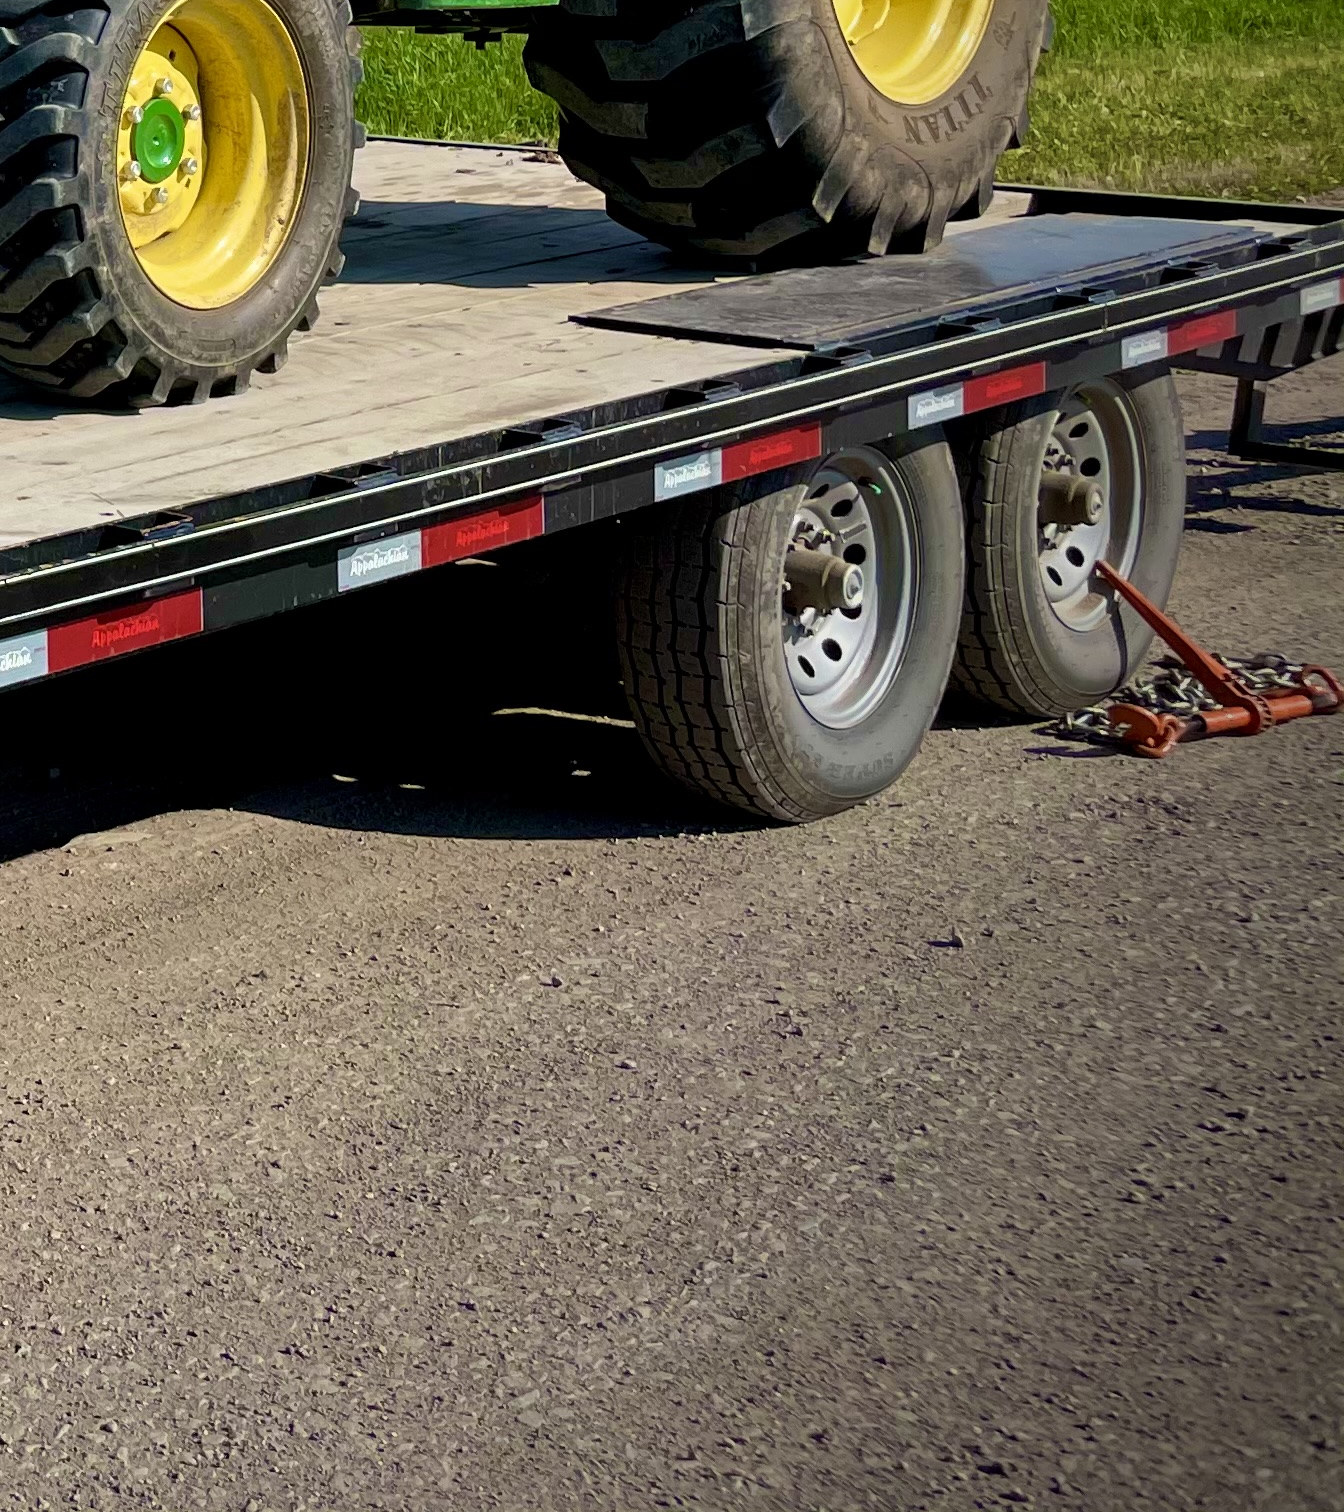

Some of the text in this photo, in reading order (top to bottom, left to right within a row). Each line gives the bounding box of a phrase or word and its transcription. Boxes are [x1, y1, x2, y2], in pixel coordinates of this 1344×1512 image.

[903, 71, 993, 146] TITAN
[350, 547, 409, 576] Appalachian
[92, 615, 161, 649] Appalachian
